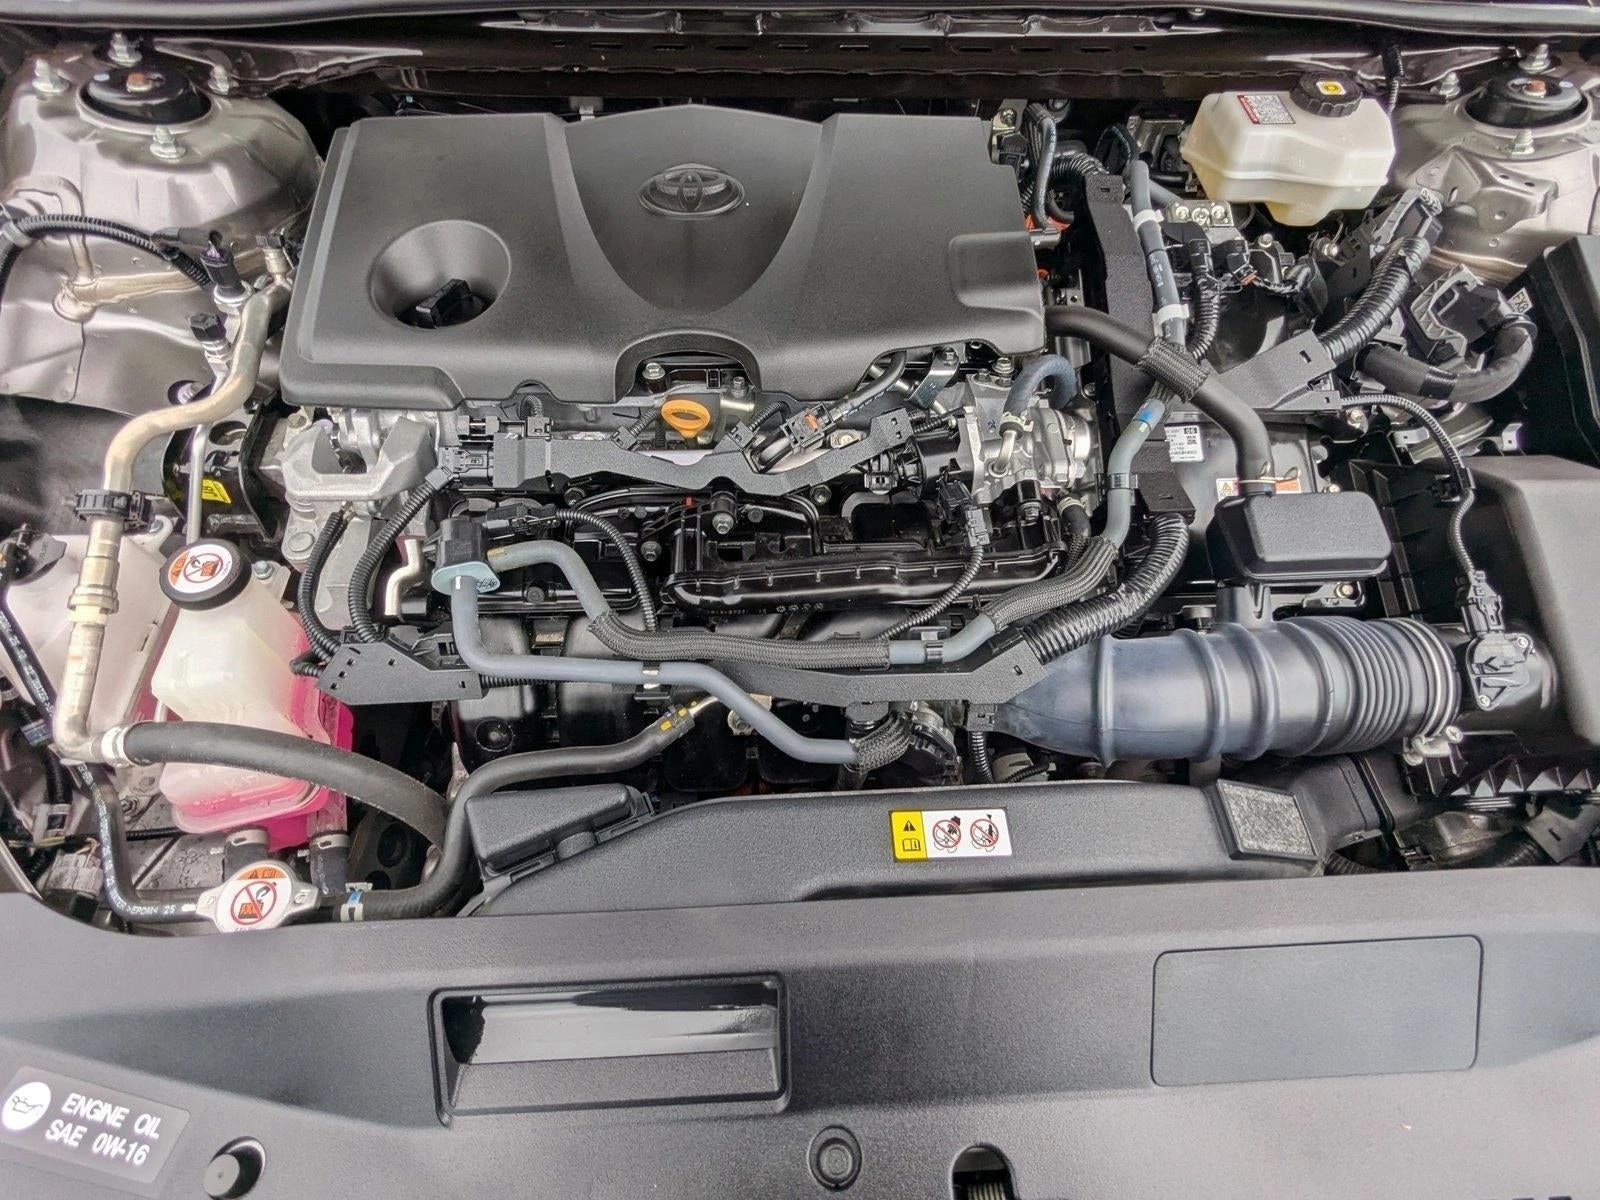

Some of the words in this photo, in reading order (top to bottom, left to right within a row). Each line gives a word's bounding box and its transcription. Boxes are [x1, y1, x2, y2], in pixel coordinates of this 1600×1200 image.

[1512, 291, 1529, 313] FX8
[31, 678, 49, 703] WATER
[110, 890, 127, 911] WATER
[126, 904, 158, 916] >EPDM<
[163, 904, 177, 916] 25
[61, 1092, 130, 1128] ENGINE
[134, 1113, 162, 1140] OIL
[45, 1119, 88, 1148] SAE
[92, 1132, 150, 1167] 0W-16
